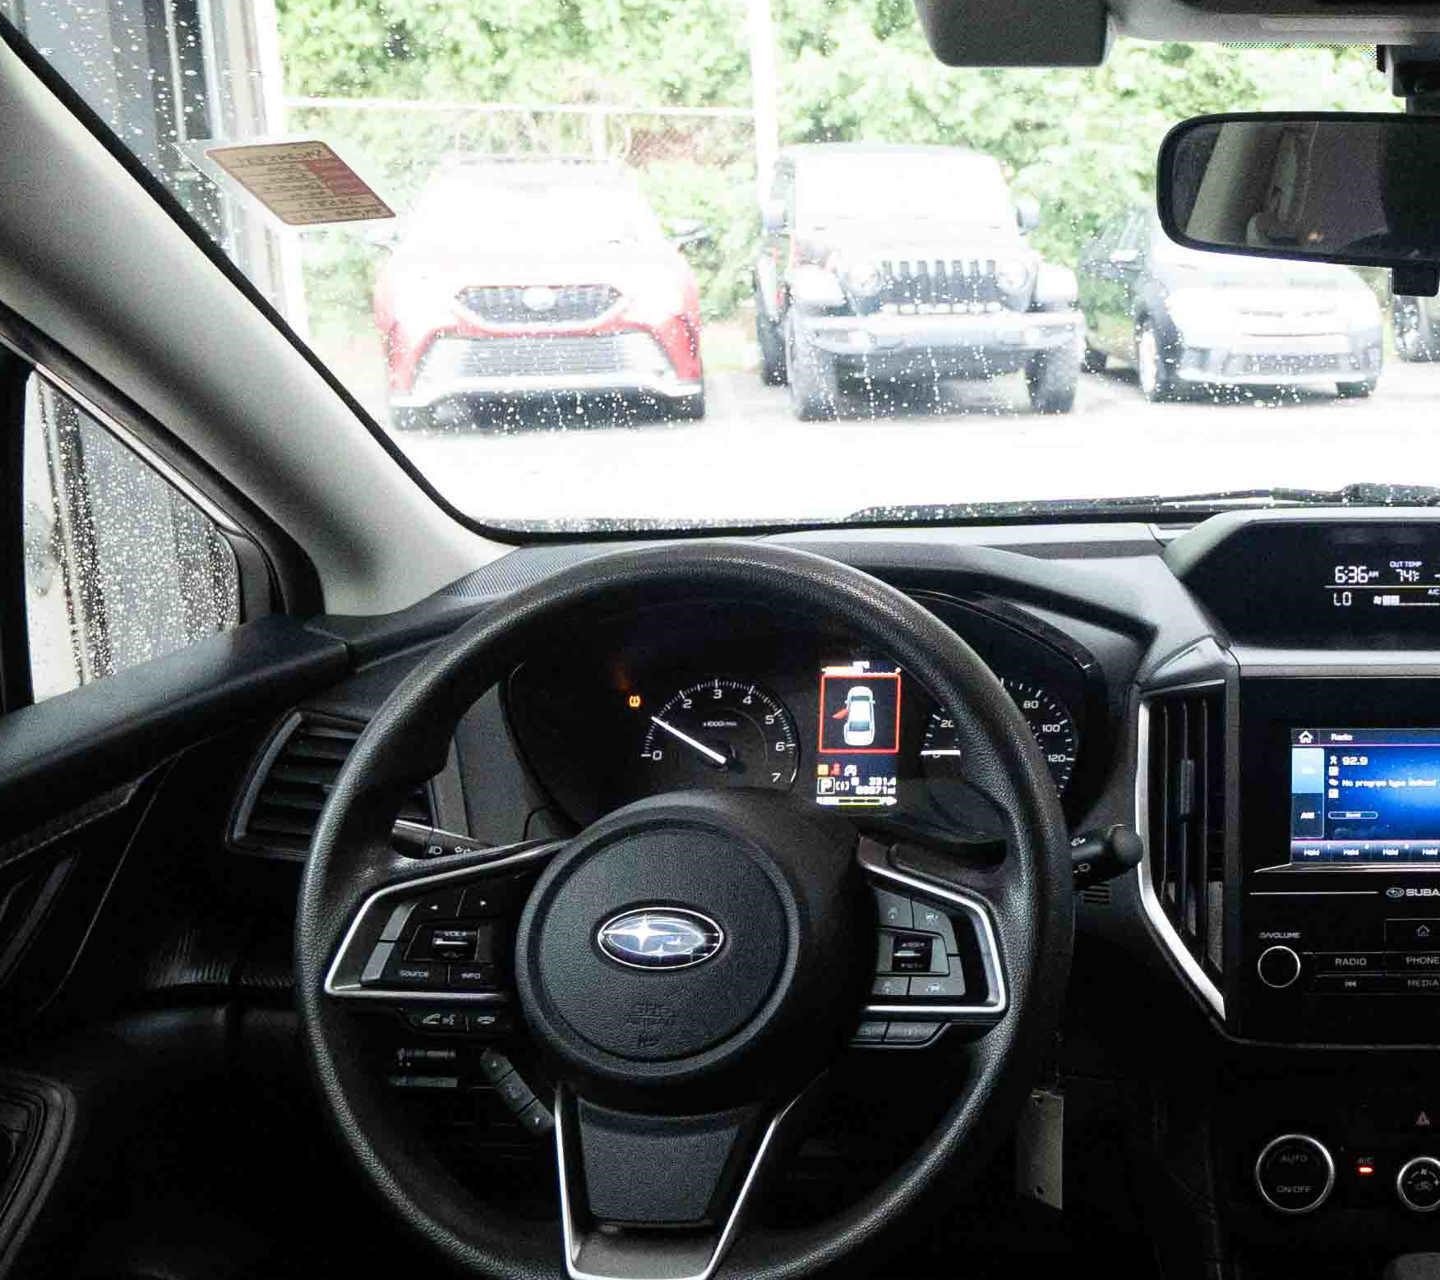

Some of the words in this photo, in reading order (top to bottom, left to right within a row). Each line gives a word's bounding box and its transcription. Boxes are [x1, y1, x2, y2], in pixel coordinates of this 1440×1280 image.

[1334, 566, 1368, 584] 6:36
[1333, 591, 1352, 606] LO
[712, 689, 723, 699] 3
[682, 699, 693, 709] 2
[742, 696, 752, 705] 4
[1023, 700, 1039, 710] 80
[764, 715, 774, 725] 5
[1042, 723, 1061, 733] 100
[775, 741, 785, 751] 6
[652, 750, 663, 761] 0
[1047, 754, 1068, 764] 120
[1342, 756, 1369, 766] 92.9
[771, 772, 781, 783] 7
[1335, 957, 1367, 967] RADIO
[1405, 955, 1440, 965] PHONE
